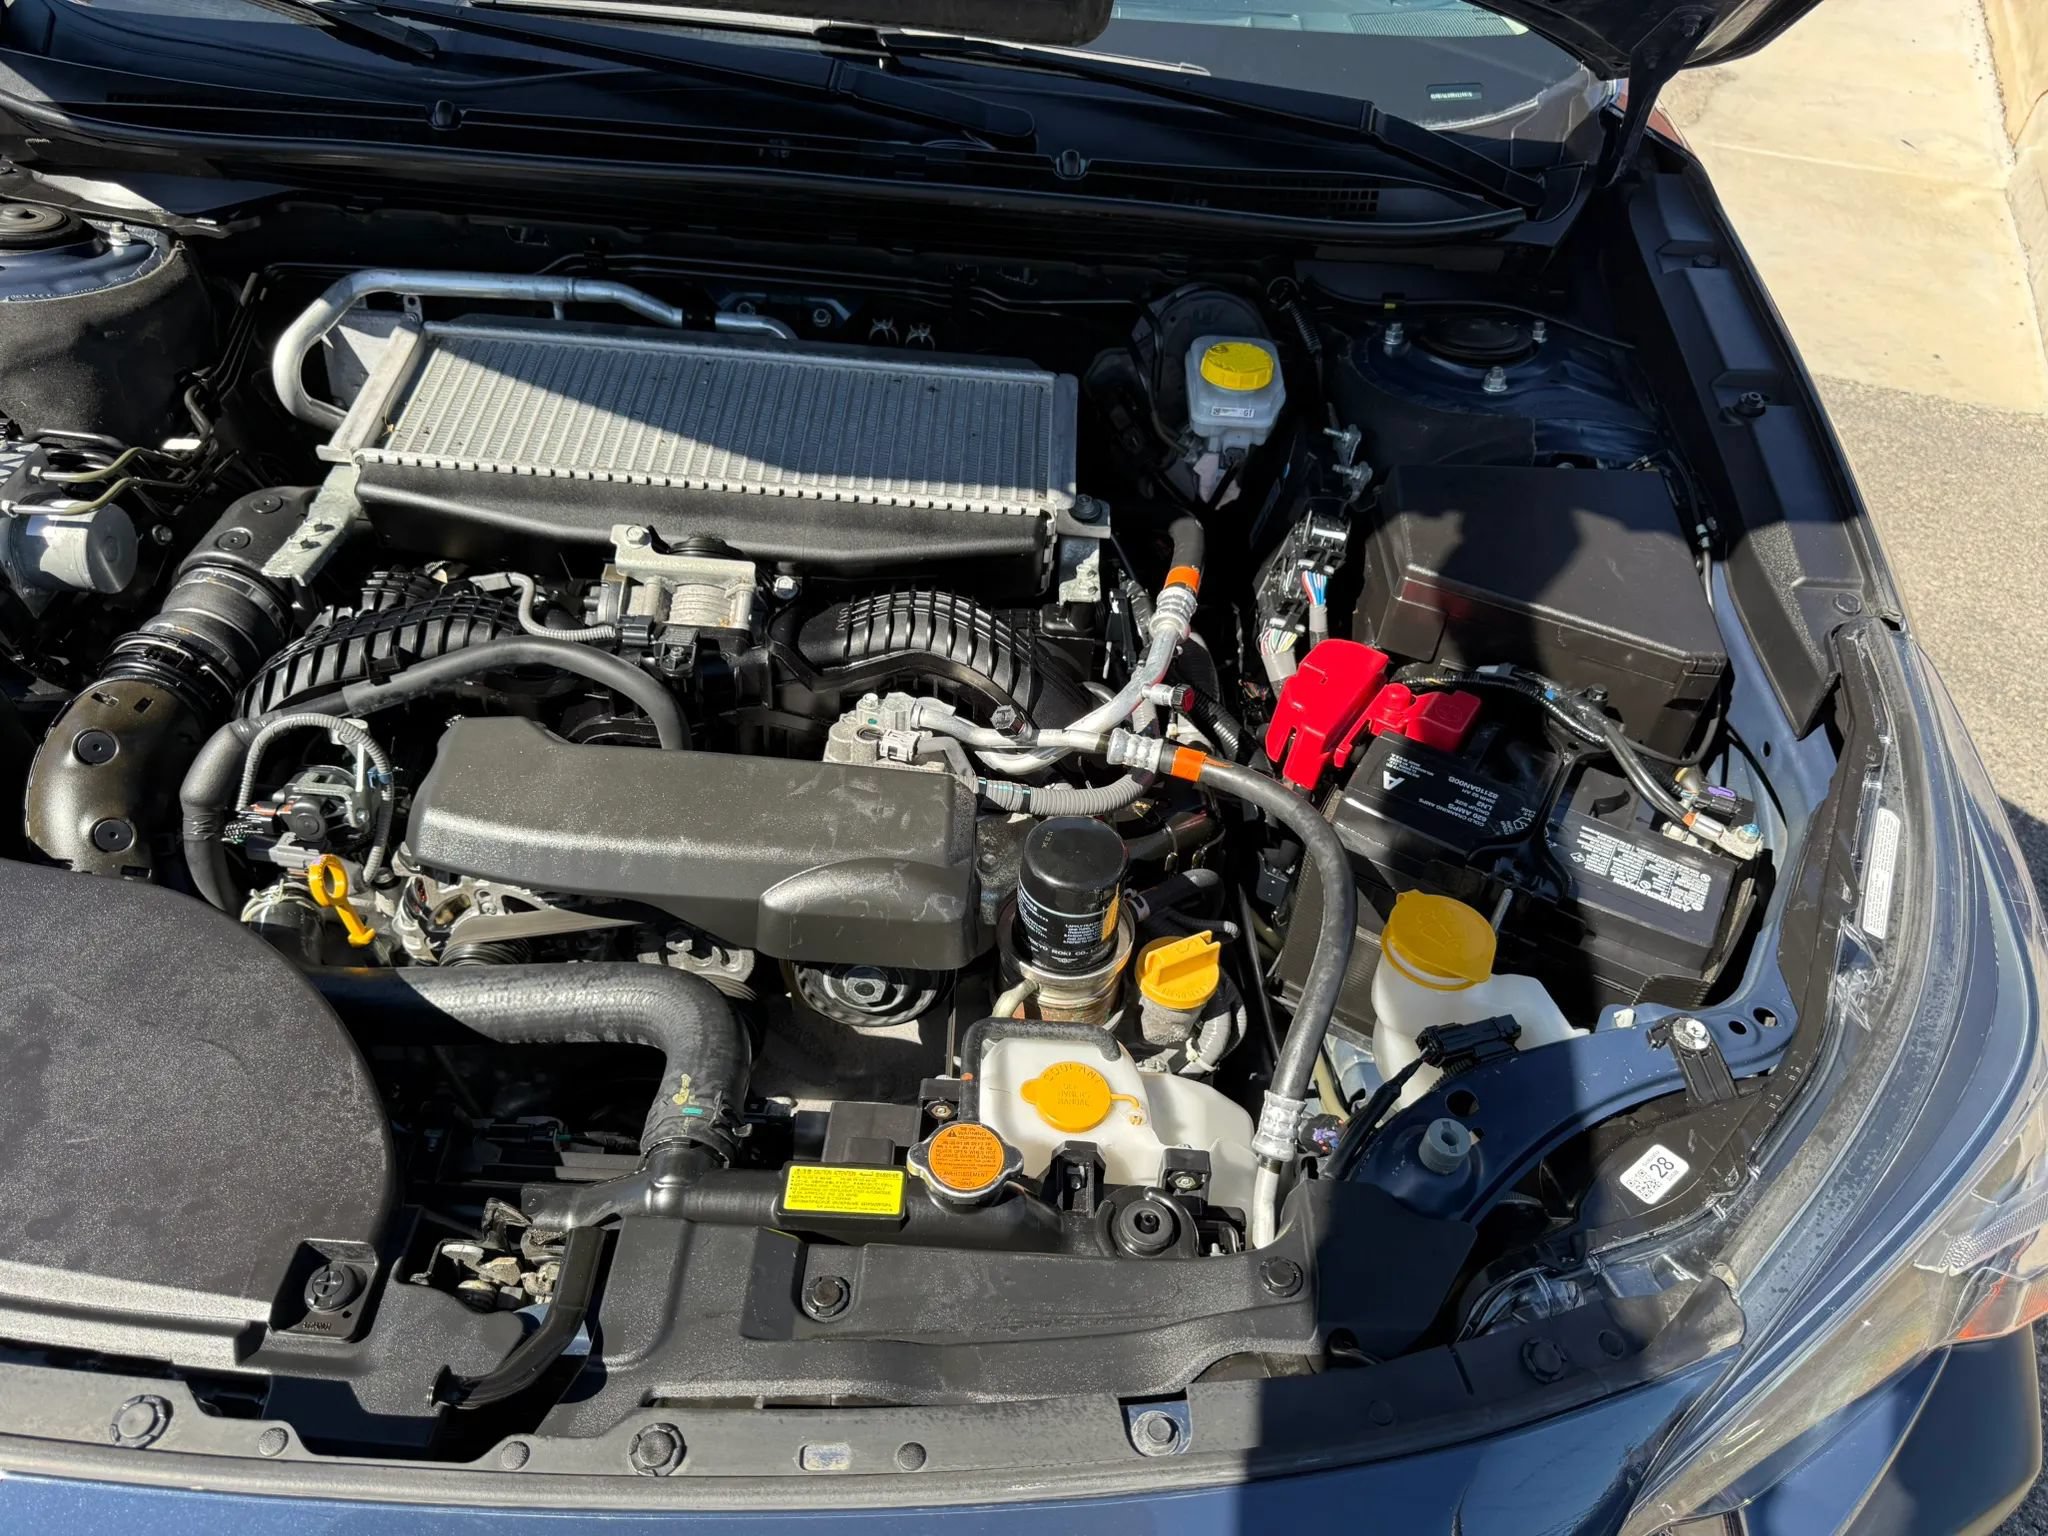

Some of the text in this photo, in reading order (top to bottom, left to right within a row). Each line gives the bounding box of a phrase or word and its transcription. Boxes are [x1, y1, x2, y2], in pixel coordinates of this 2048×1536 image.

[1448, 803, 1471, 815] AMPS
[1051, 949, 1072, 957] ROKI
[1649, 1156, 1675, 1178] 28
